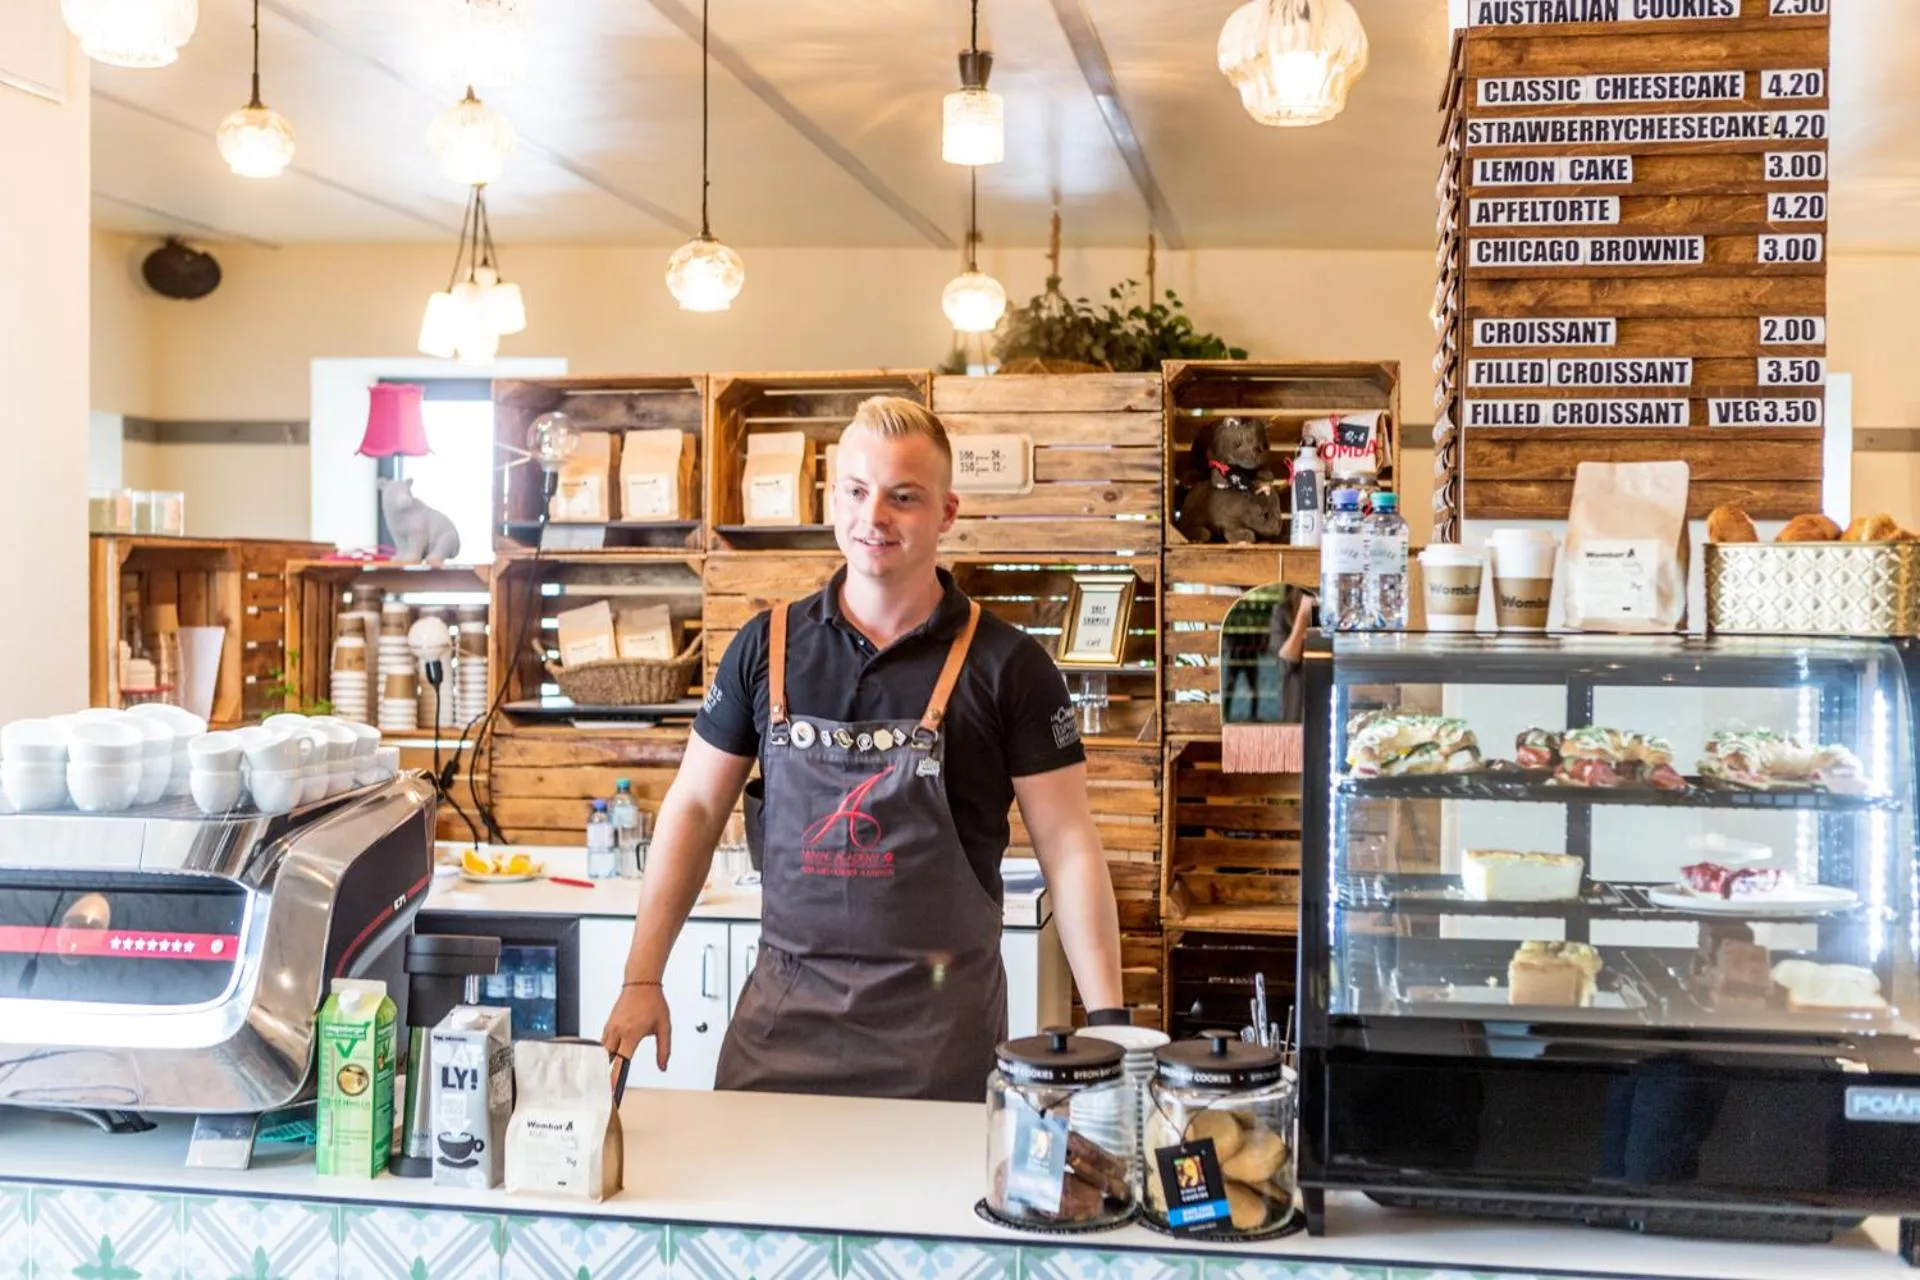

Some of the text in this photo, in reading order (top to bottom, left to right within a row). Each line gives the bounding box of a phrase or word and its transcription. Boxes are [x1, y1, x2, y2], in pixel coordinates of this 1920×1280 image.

[1478, 0, 1619, 24] AUSTRALIAN
[1632, 0, 1735, 19] COOKIES
[1483, 72, 1821, 102] CLASSIC CHEESECAKE 4.20
[1773, 114, 1827, 139] 4.20
[1479, 154, 1822, 182] LEMON CAKE 3.00
[1476, 195, 1825, 223] APFELTORTE 4.20
[1476, 237, 1817, 263] CHICAGO BROWNIE 3.00
[1480, 318, 1816, 344] CROISSANT 2.00
[1475, 359, 1821, 384] FILLED CROISSANT 3.50
[1471, 400, 1817, 425] FILLED CROISSANT VEG 3.50
[441, 1066, 478, 1091] LY!
